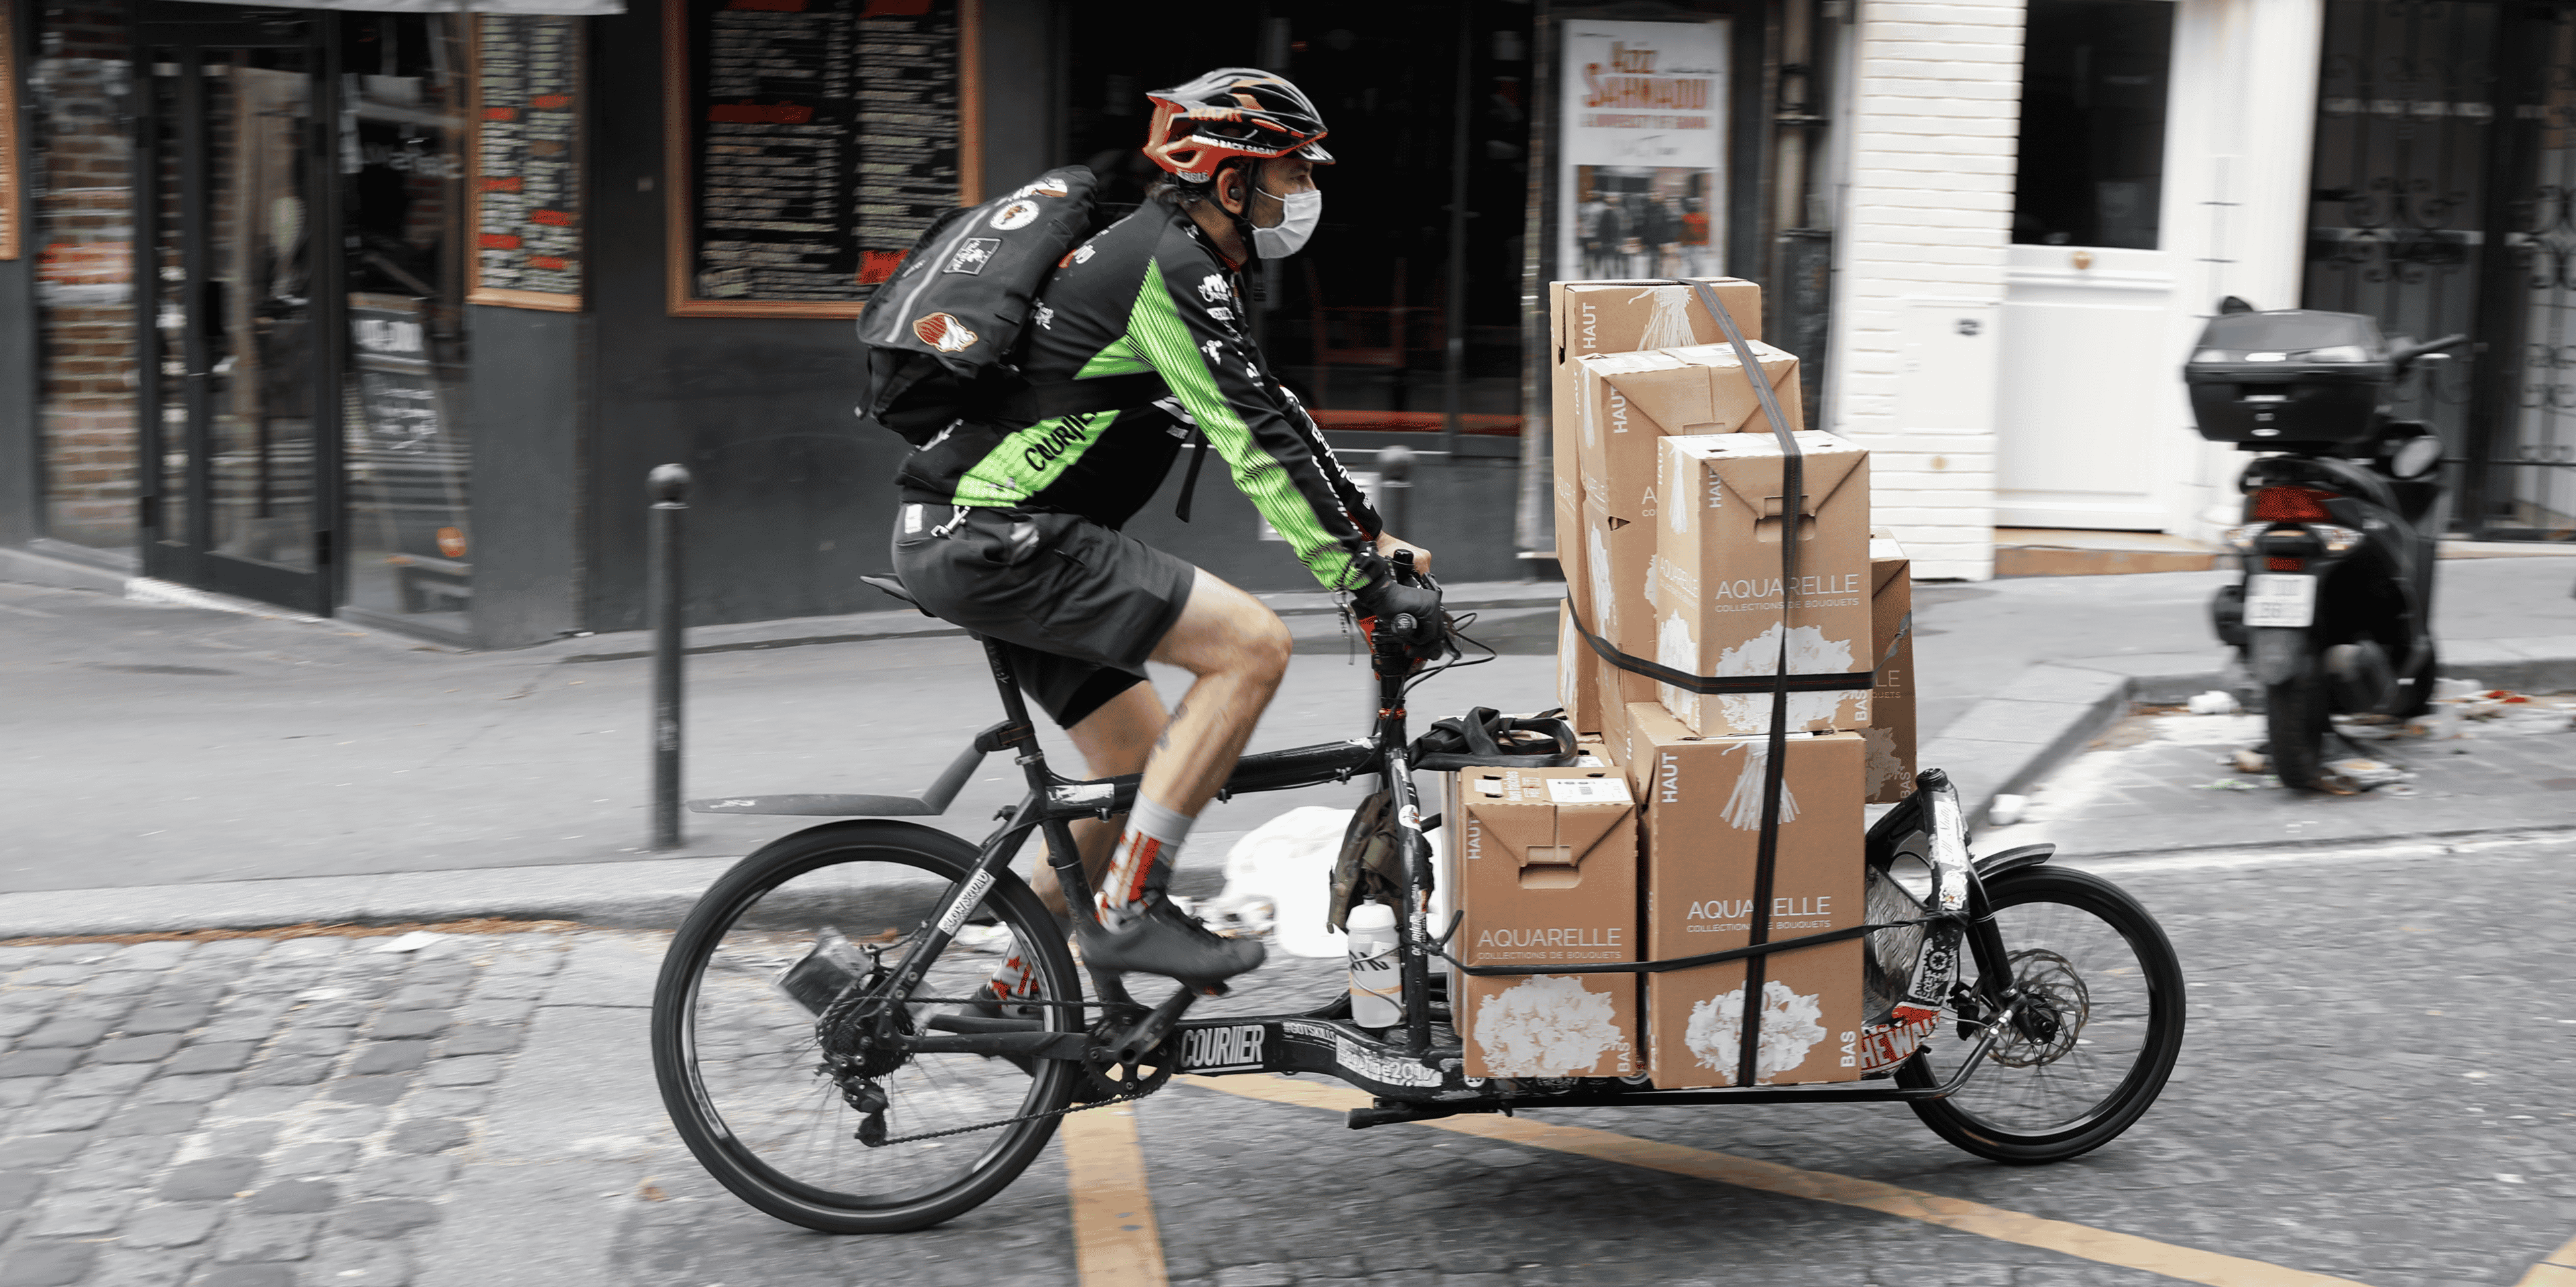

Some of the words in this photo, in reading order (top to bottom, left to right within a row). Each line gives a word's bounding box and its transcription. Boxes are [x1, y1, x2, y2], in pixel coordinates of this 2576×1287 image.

[1220, 140, 1244, 152] BACK
[1246, 145, 1278, 156] SAGAN
[1582, 302, 1596, 349] HAUT
[1709, 469, 1723, 508] HAU
[1715, 573, 1860, 600] AQUARELLE
[1715, 601, 1784, 613] COLLECTIONS
[1786, 601, 1801, 609] DE
[1805, 598, 1860, 608] BOUQUETS
[1854, 690, 1868, 722] BAS
[1662, 752, 1678, 803] HAUT
[1899, 769, 1911, 799] BAS
[1686, 896, 1832, 919] AQUAELLE
[1477, 928, 1622, 948] AQUARELLE
[1686, 923, 1750, 932] COLLECTION
[1776, 919, 1832, 930] BOUQUETS
[1477, 951, 1547, 960] COLLECTIONS
[1550, 951, 1564, 960] DE
[1566, 950, 1622, 960] BOUQUETS
[1617, 1042, 1631, 1072] BAS
[1841, 1030, 1856, 1067] BAS
